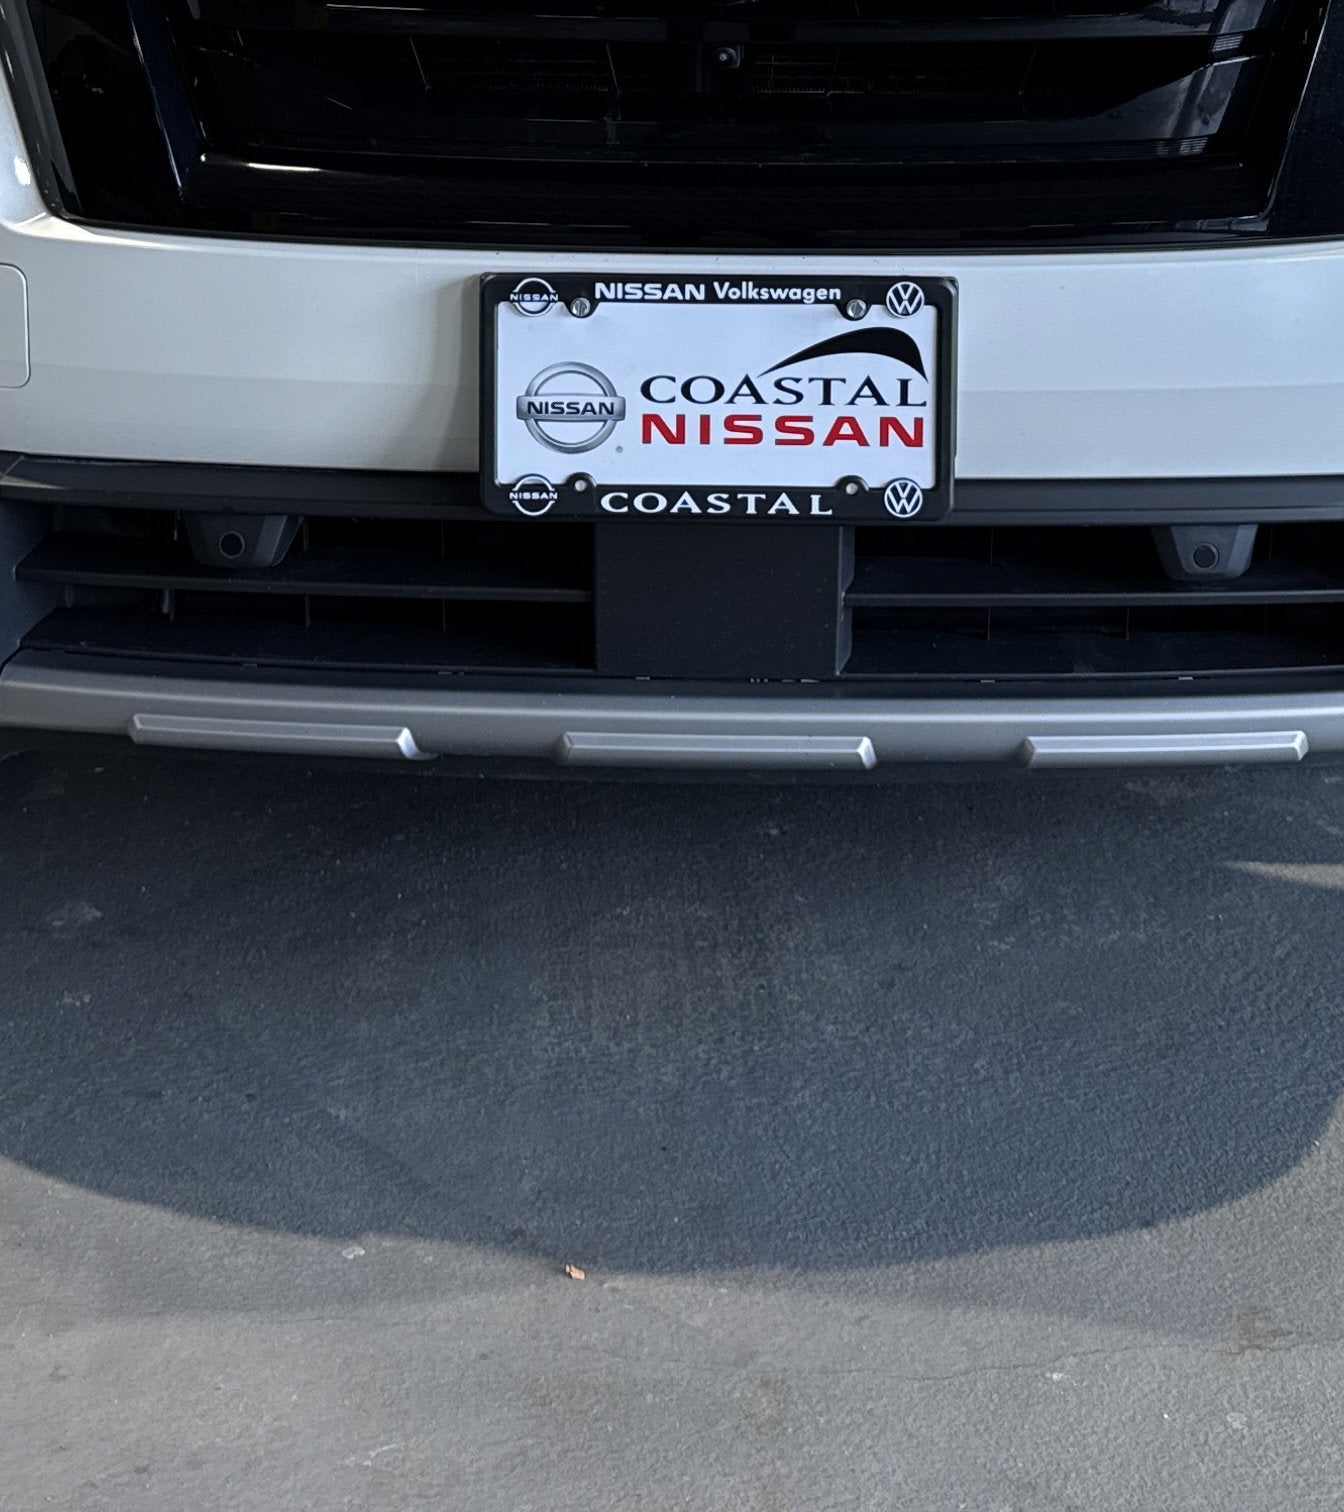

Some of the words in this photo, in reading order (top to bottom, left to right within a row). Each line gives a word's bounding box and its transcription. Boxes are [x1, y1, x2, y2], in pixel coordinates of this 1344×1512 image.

[510, 293, 558, 302] NISSAN
[595, 282, 705, 301] NISSAN
[713, 281, 841, 303] Volkswagen
[640, 374, 927, 406] COASTAL
[527, 401, 615, 416] NISSAN
[642, 414, 924, 448] NISSAN
[509, 492, 558, 500] NISSAN
[600, 491, 833, 516] COASTAL
